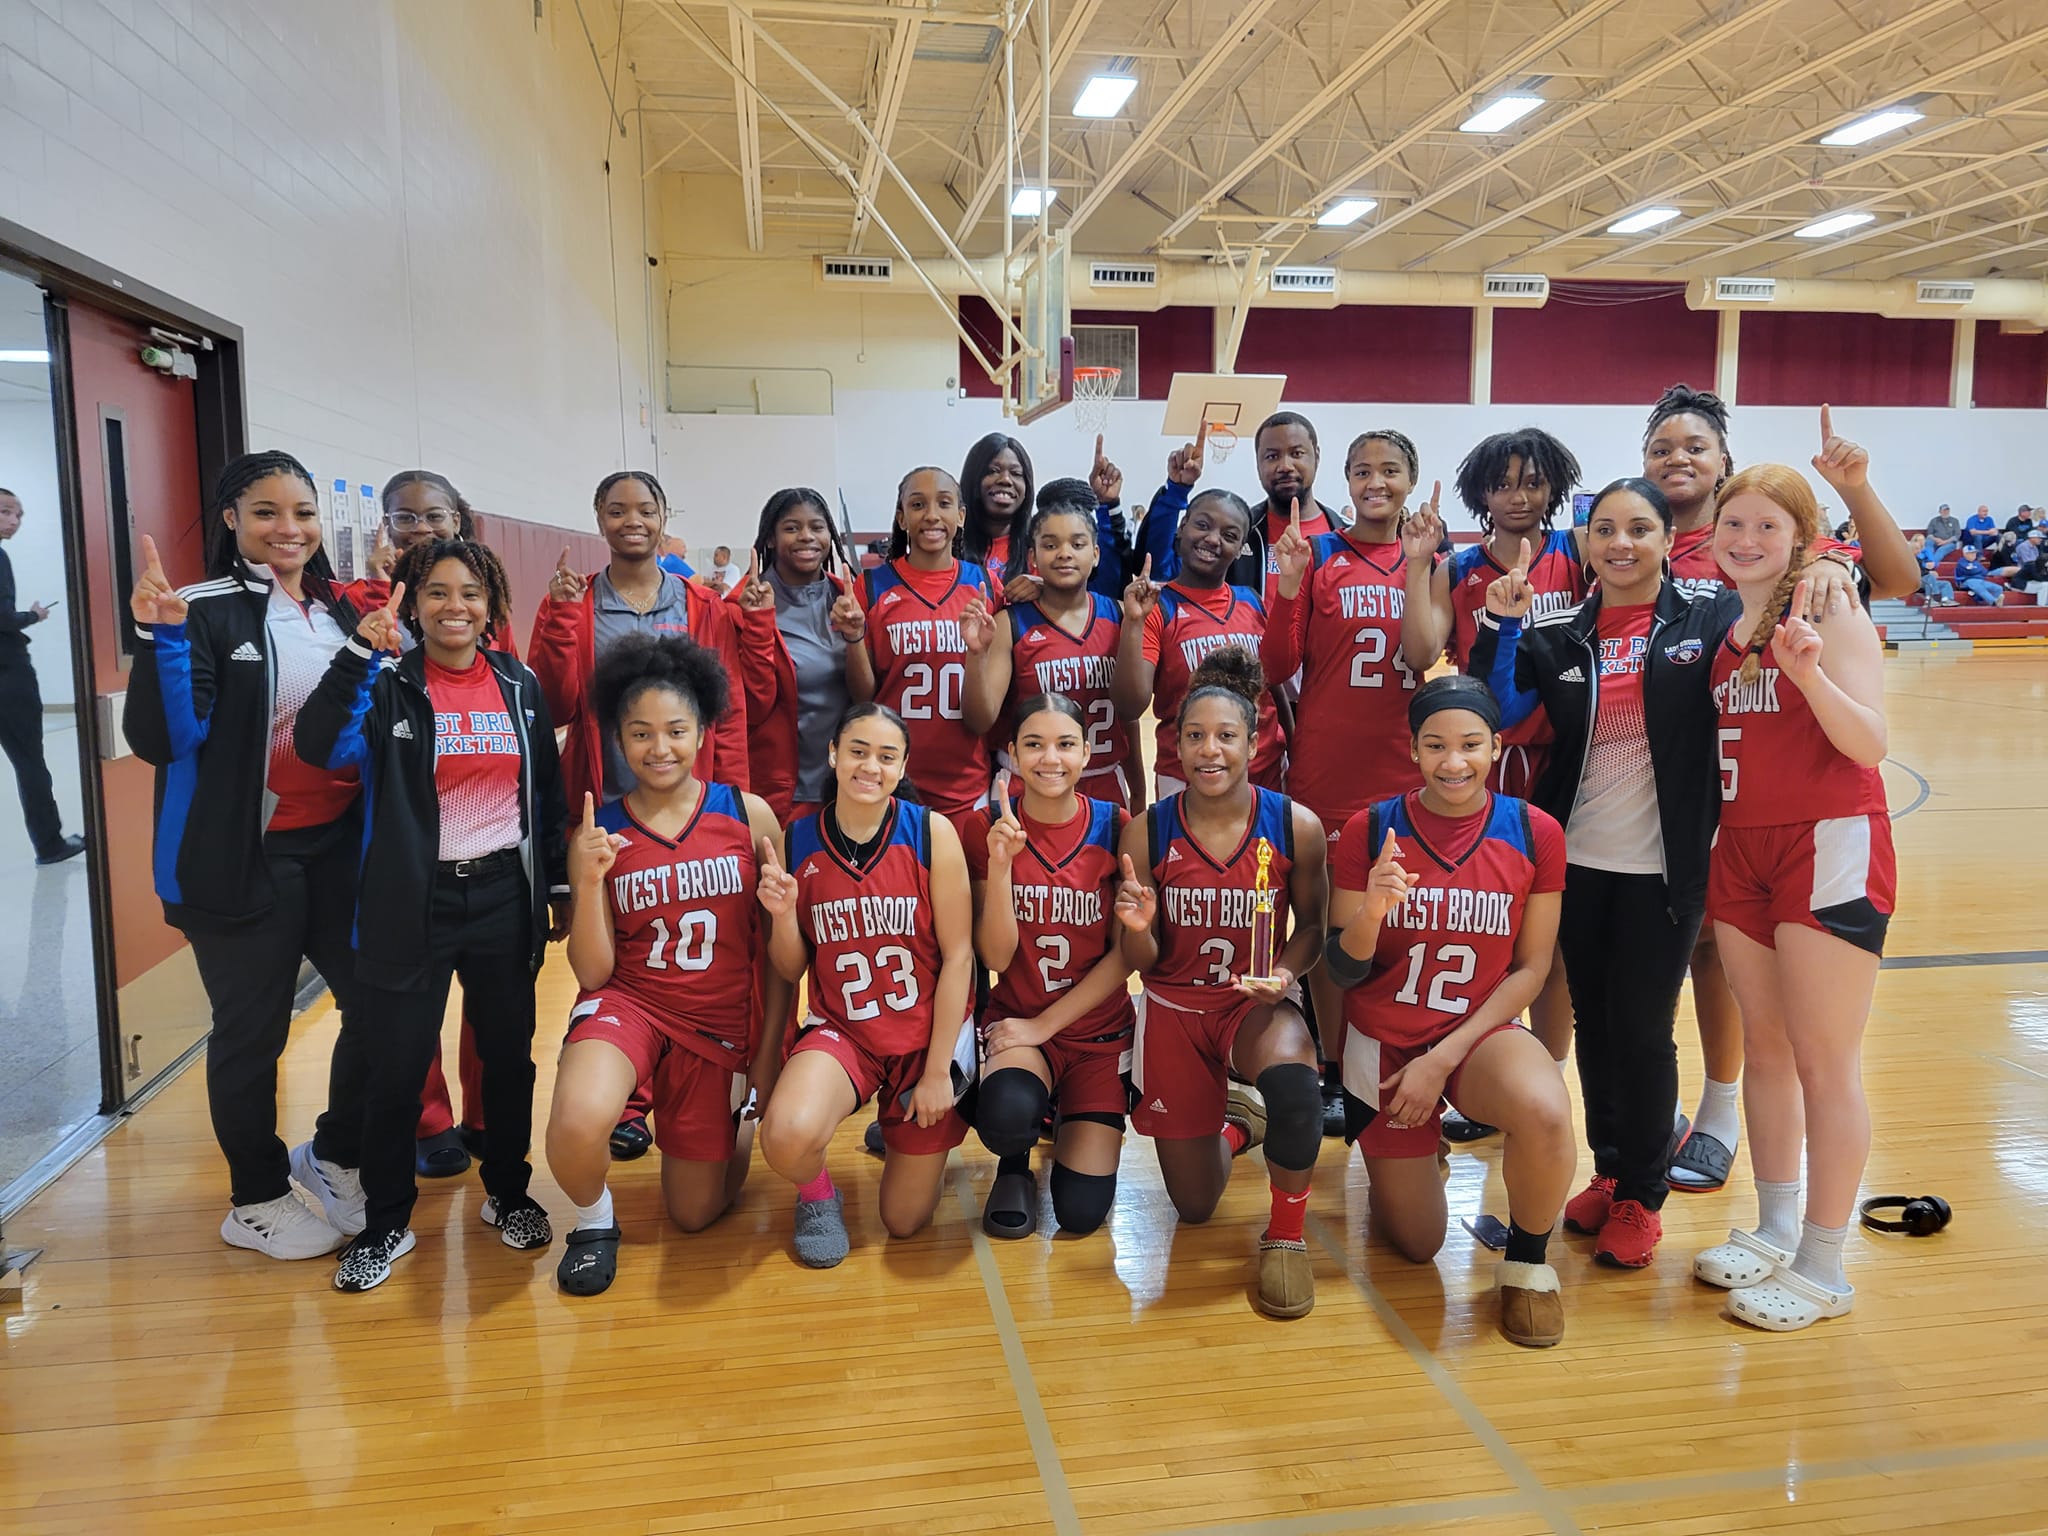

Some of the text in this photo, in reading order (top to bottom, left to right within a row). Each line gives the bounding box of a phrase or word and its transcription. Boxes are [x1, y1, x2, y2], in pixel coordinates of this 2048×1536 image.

[1339, 585, 1387, 620] WEST
[887, 619, 968, 656] WEST BRO
[901, 662, 966, 720] 20
[1035, 657, 1081, 694] WEST
[468, 710, 517, 735] BRO
[614, 855, 744, 915] WEST BROOK
[1012, 884, 1104, 927] EST BROOK
[1165, 886, 1217, 929] WEST
[811, 896, 918, 945] WEST BROOK
[1446, 887, 1514, 936] BROOK
[645, 908, 718, 971] 10
[1035, 934, 1073, 993] 2
[1193, 937, 1236, 987] 3
[835, 945, 920, 1022] 23
[1394, 942, 1477, 1015] 12
